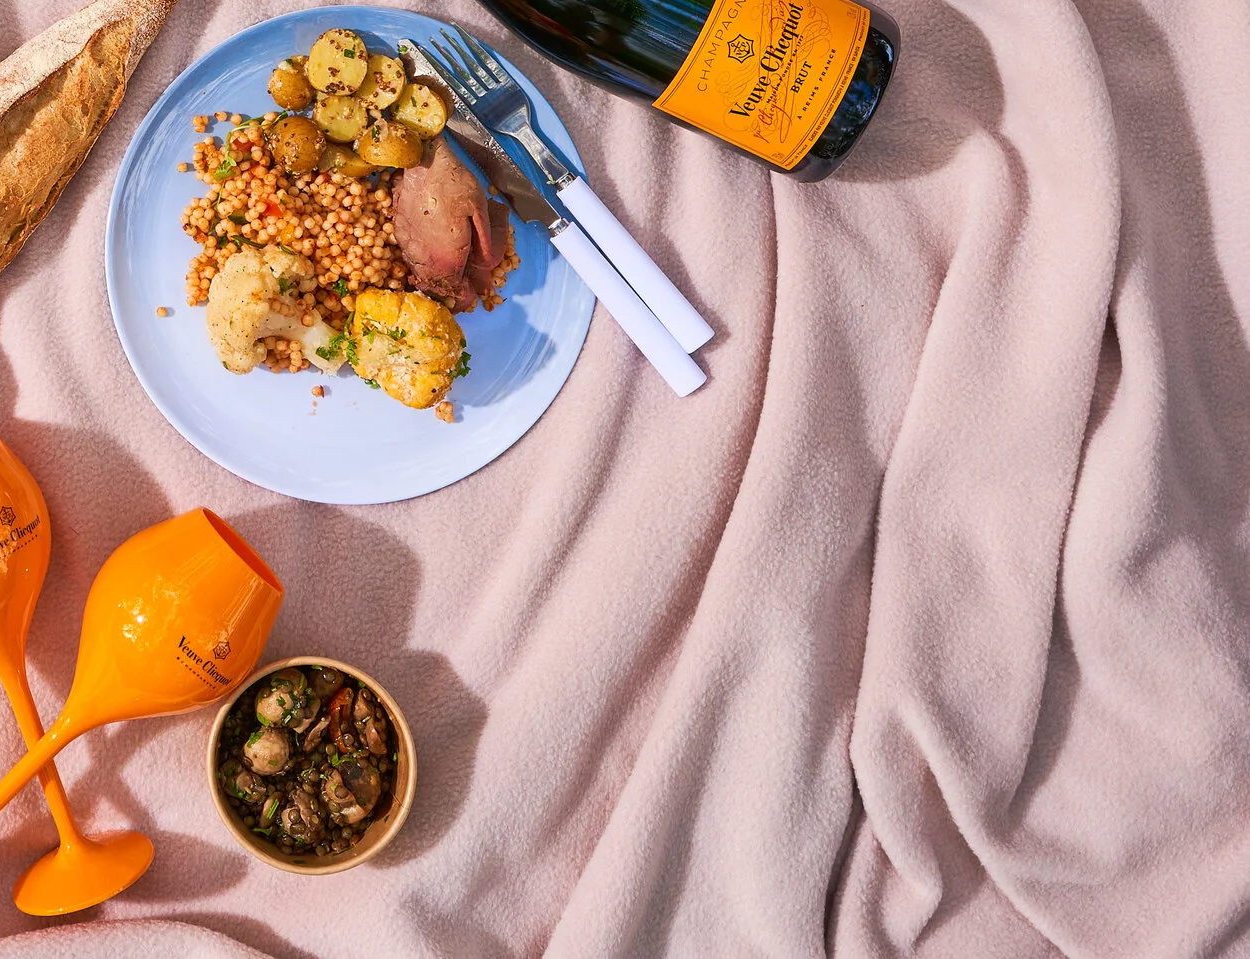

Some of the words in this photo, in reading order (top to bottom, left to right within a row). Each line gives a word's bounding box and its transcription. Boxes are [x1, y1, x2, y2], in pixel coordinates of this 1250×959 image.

[728, 75, 772, 117] Veuve
[760, 2, 804, 73] Clicquot
[790, 60, 813, 94] BRUT
[802, 86, 819, 112] REIMS
[818, 48, 837, 82] FRANCE
[9, 515, 41, 542] Clicquot
[177, 635, 203, 666] Veuve
[201, 660, 232, 686] Clicquot
